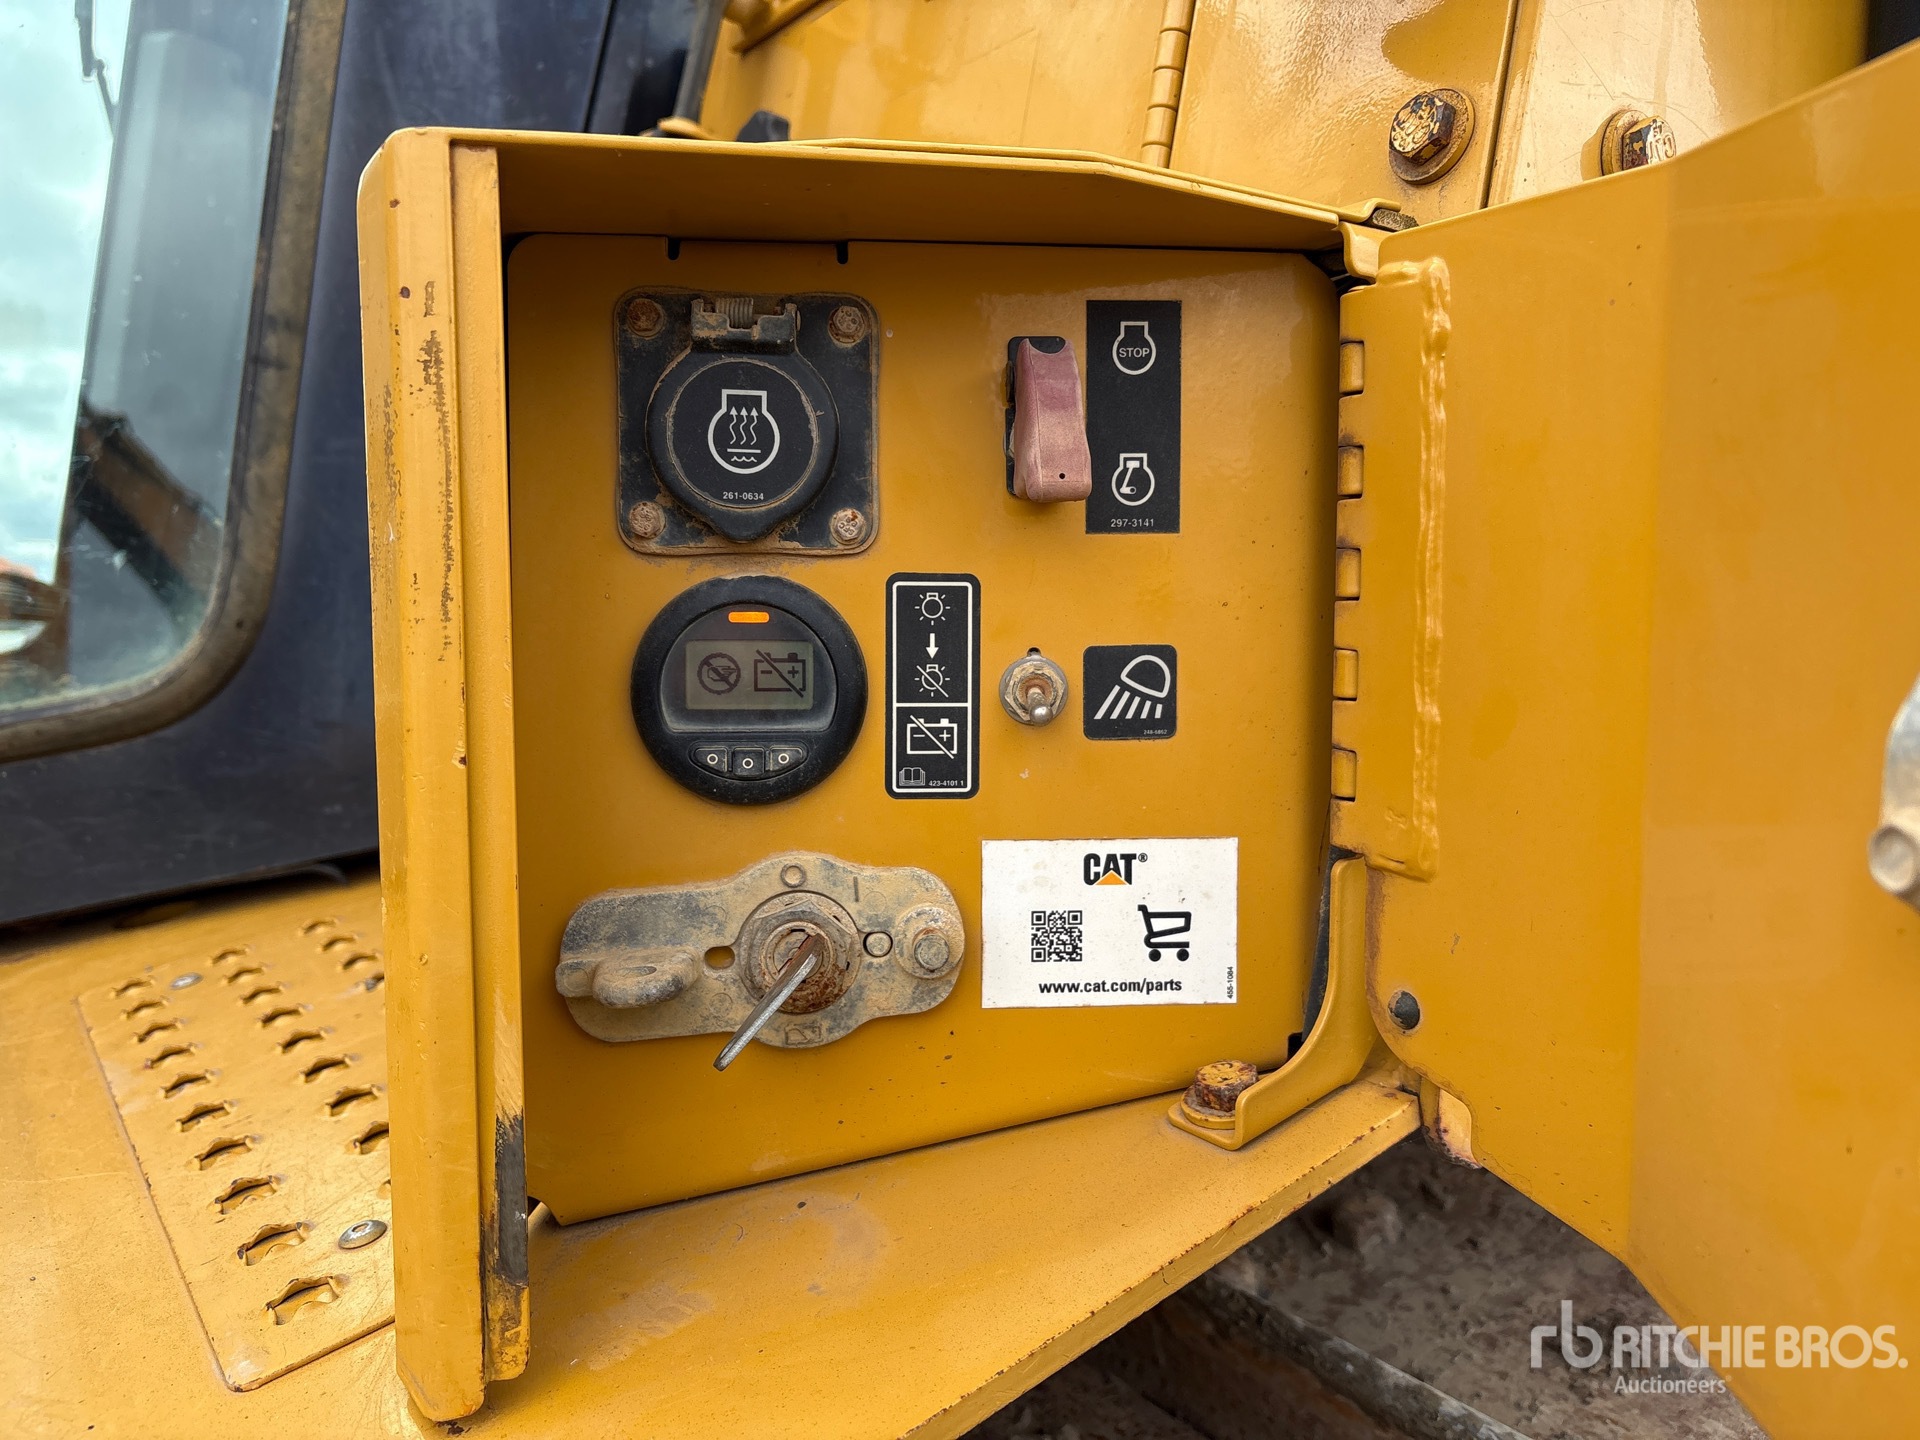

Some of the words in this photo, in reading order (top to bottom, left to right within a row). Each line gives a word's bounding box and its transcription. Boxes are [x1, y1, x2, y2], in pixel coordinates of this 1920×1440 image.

[1119, 347, 1150, 358] STOP
[722, 491, 764, 500] 261-0634
[1110, 518, 1154, 528] 297-3141
[1038, 977, 1182, 995] www.cat.com/parts
[1226, 966, 1234, 999] 455-1084
